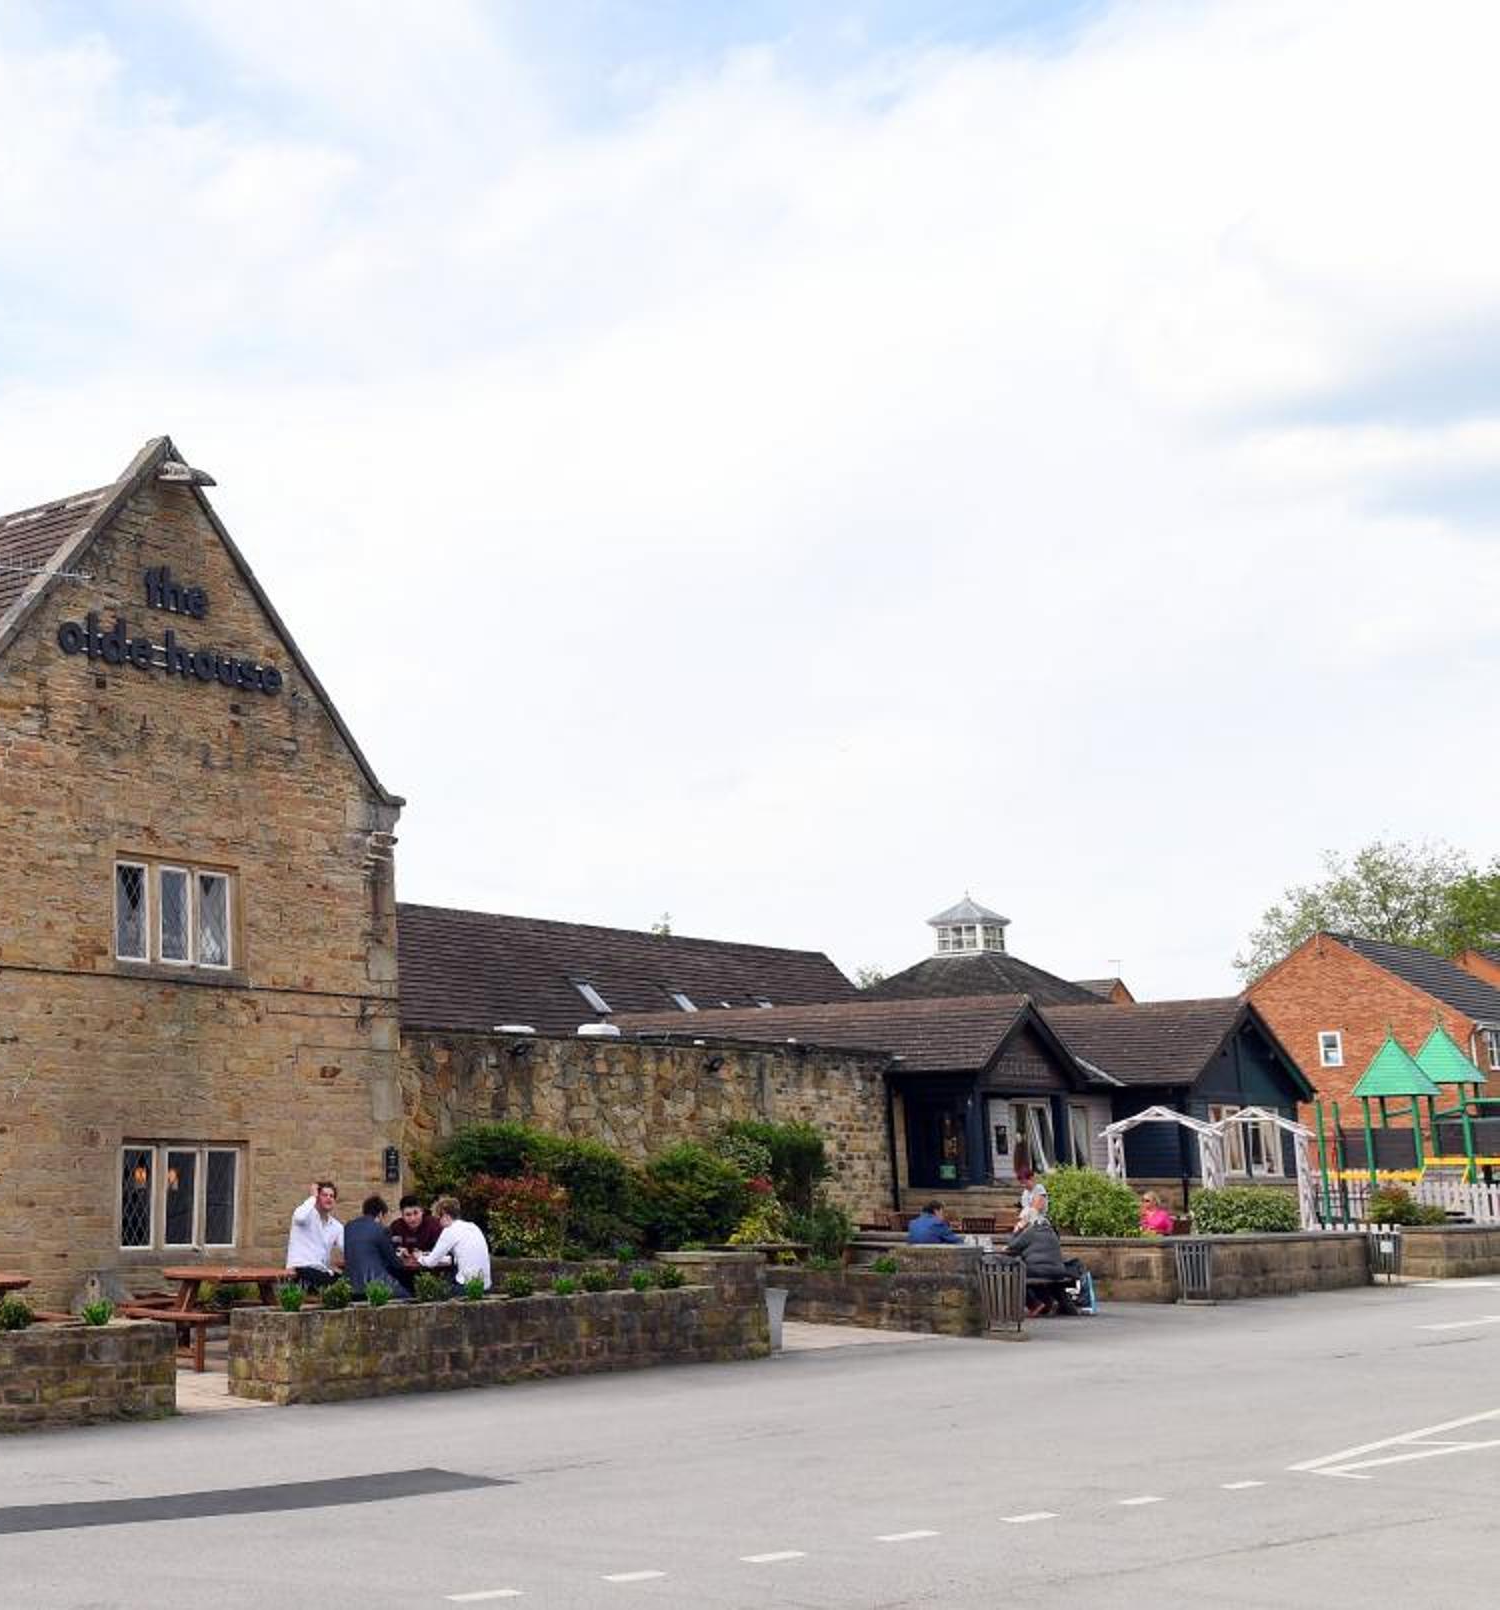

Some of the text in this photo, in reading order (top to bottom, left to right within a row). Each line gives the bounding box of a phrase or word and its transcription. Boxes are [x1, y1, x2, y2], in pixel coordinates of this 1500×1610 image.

[143, 565, 209, 620] the
[58, 609, 283, 696] olde house
